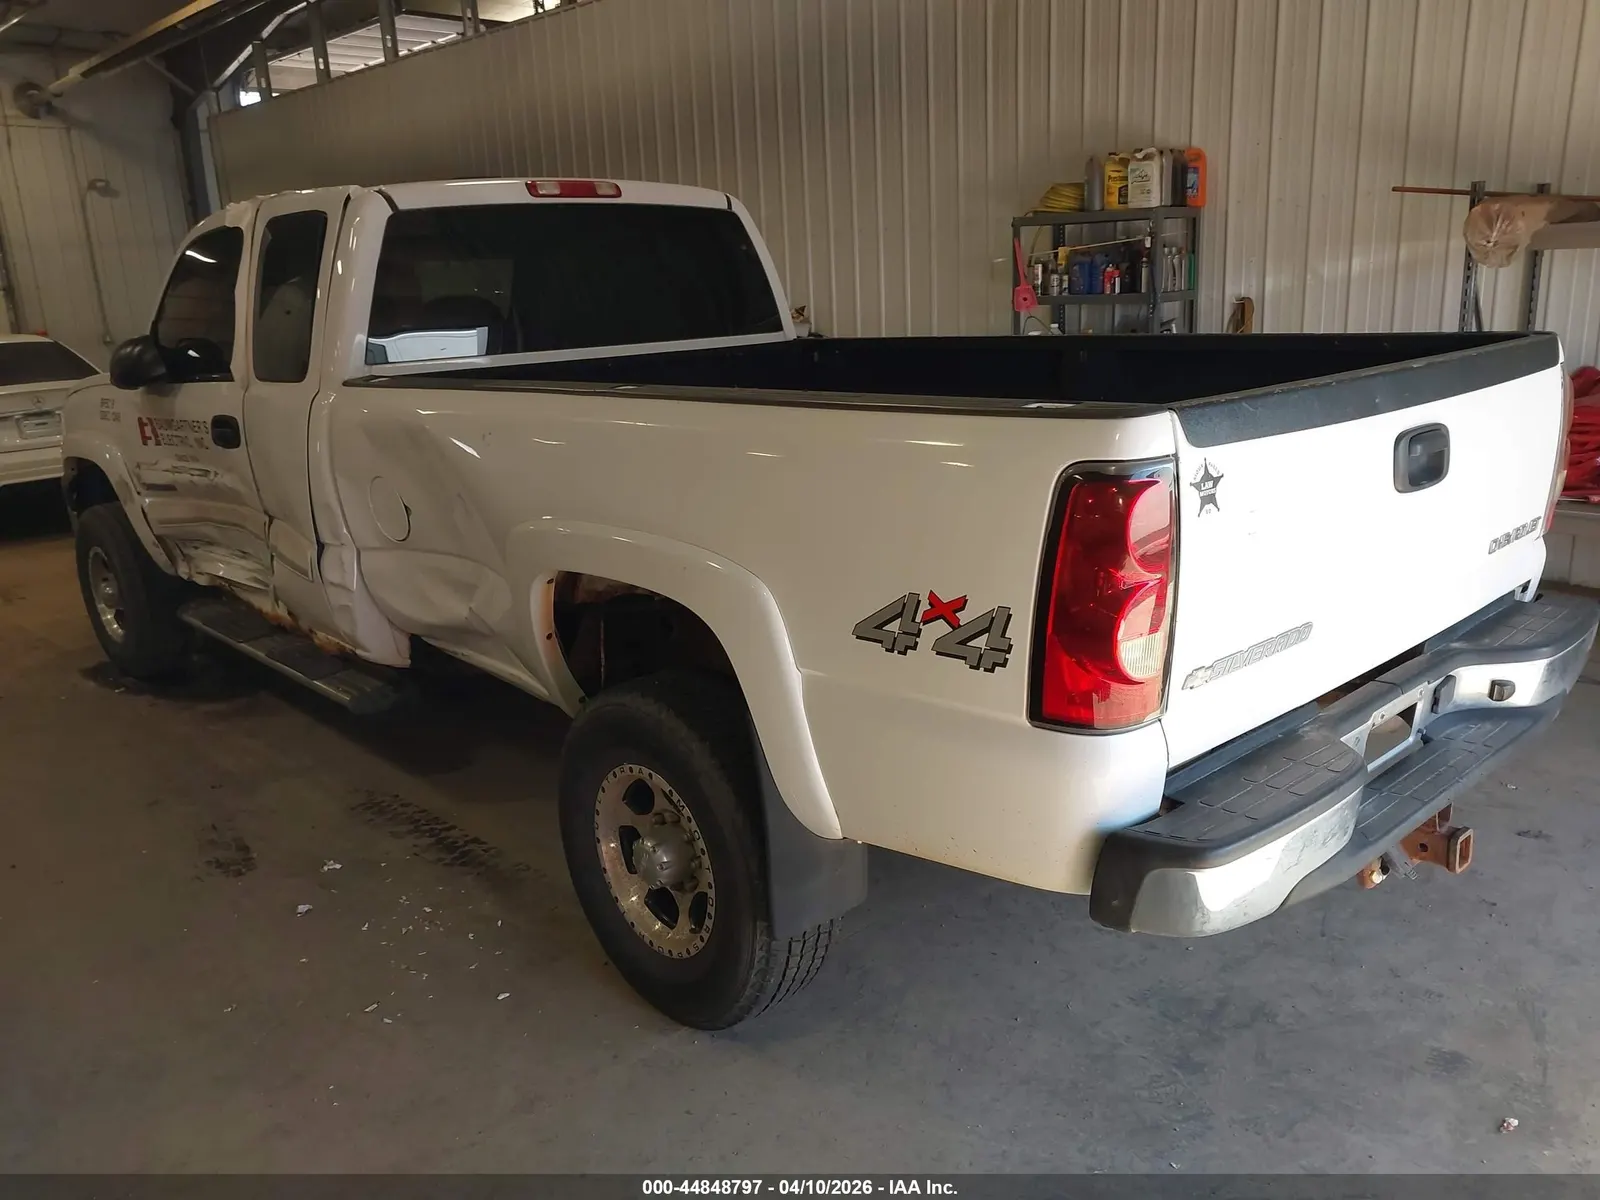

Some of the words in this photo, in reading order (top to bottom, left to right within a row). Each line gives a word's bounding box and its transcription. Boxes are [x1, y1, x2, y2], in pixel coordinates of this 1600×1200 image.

[1201, 480, 1214, 491] LAW
[1488, 516, 1542, 555] CHEVROLET
[1208, 621, 1314, 684] SILVERADO
